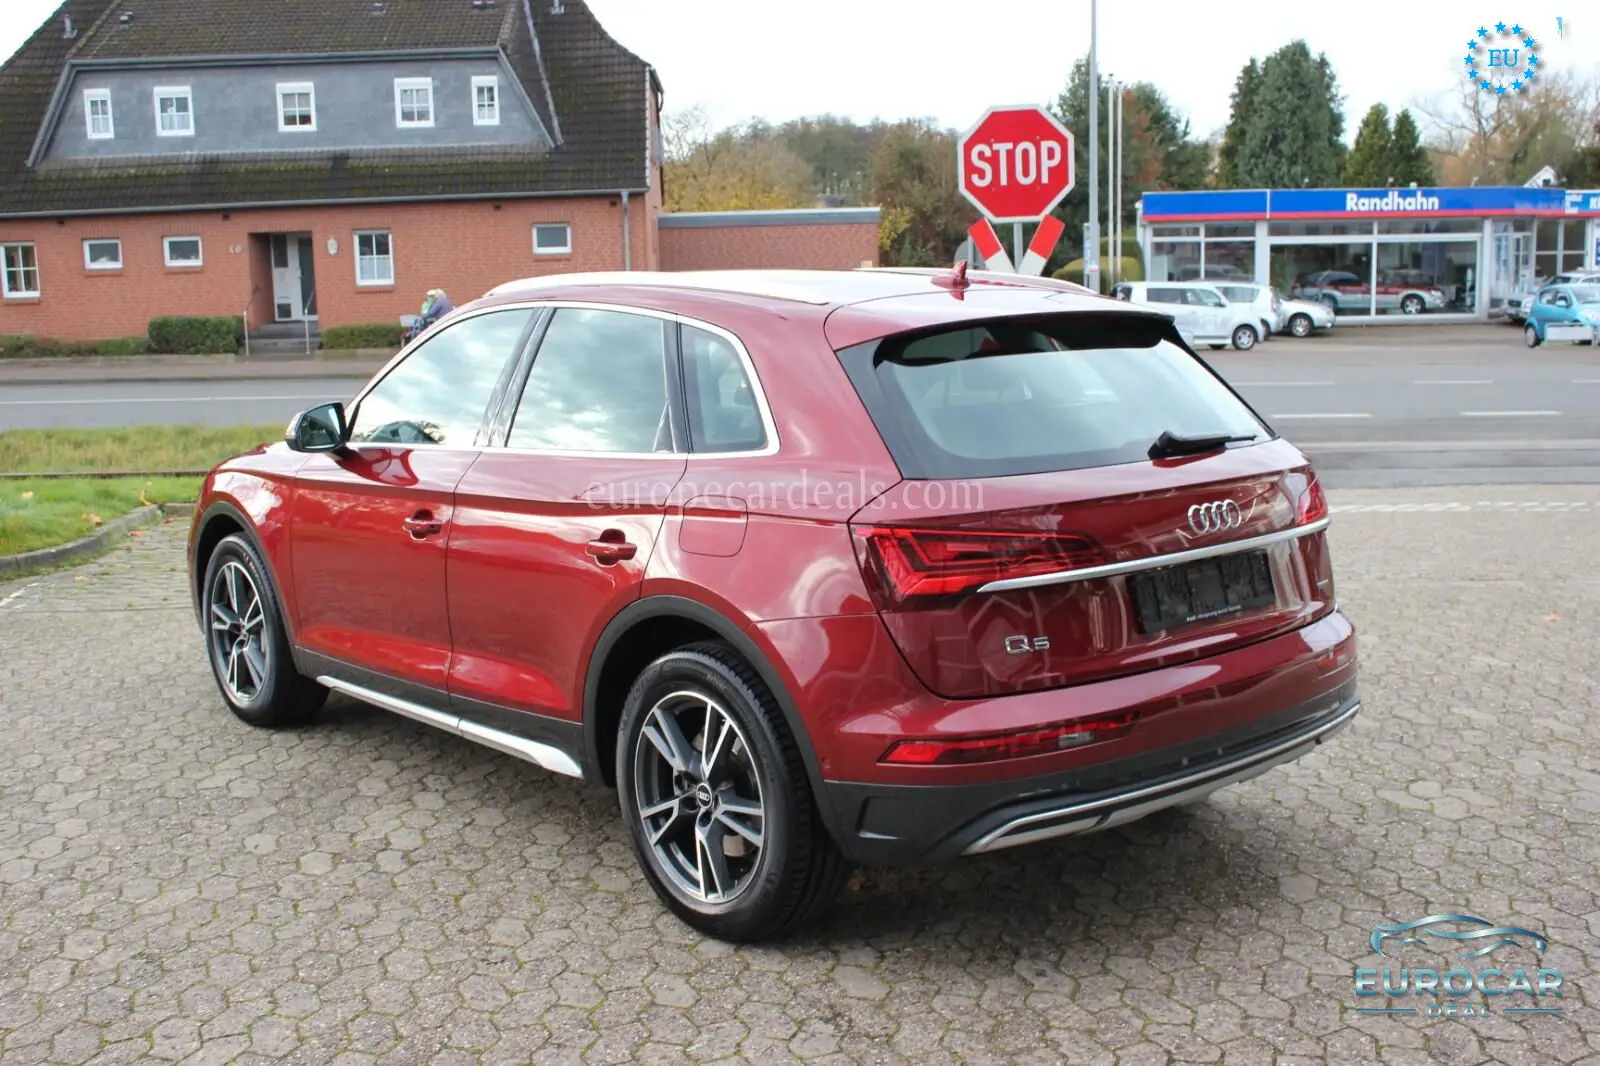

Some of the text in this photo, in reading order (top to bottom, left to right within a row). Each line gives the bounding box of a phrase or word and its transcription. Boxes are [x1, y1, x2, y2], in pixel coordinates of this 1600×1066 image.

[970, 140, 1061, 187] STOP
[1346, 191, 1439, 211] Randhahn
[1005, 635, 1050, 655] Q5
